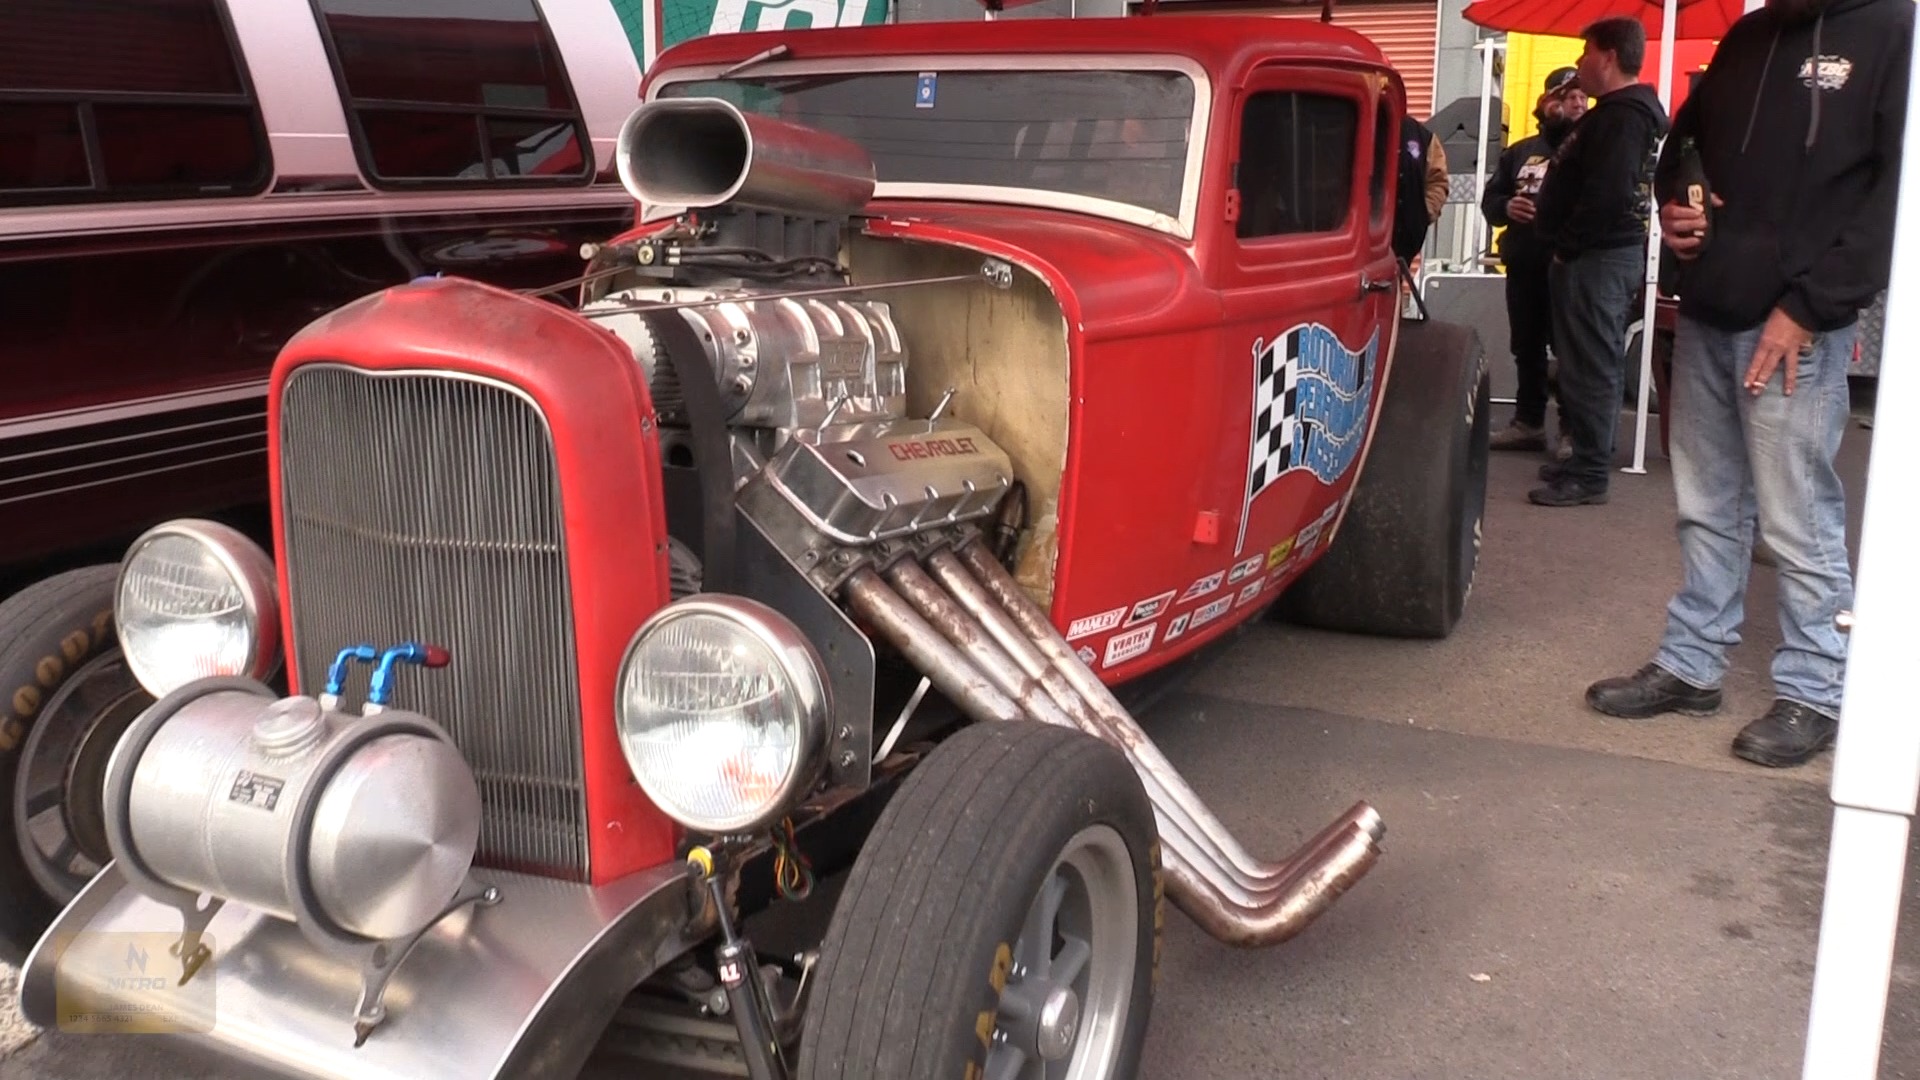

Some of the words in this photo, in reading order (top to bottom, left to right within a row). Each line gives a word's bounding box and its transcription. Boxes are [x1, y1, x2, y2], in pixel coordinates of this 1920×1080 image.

[888, 437, 979, 461] CHEVROLET
[1068, 608, 1122, 637] MANLEY
[1112, 627, 1152, 652] VERTEX
